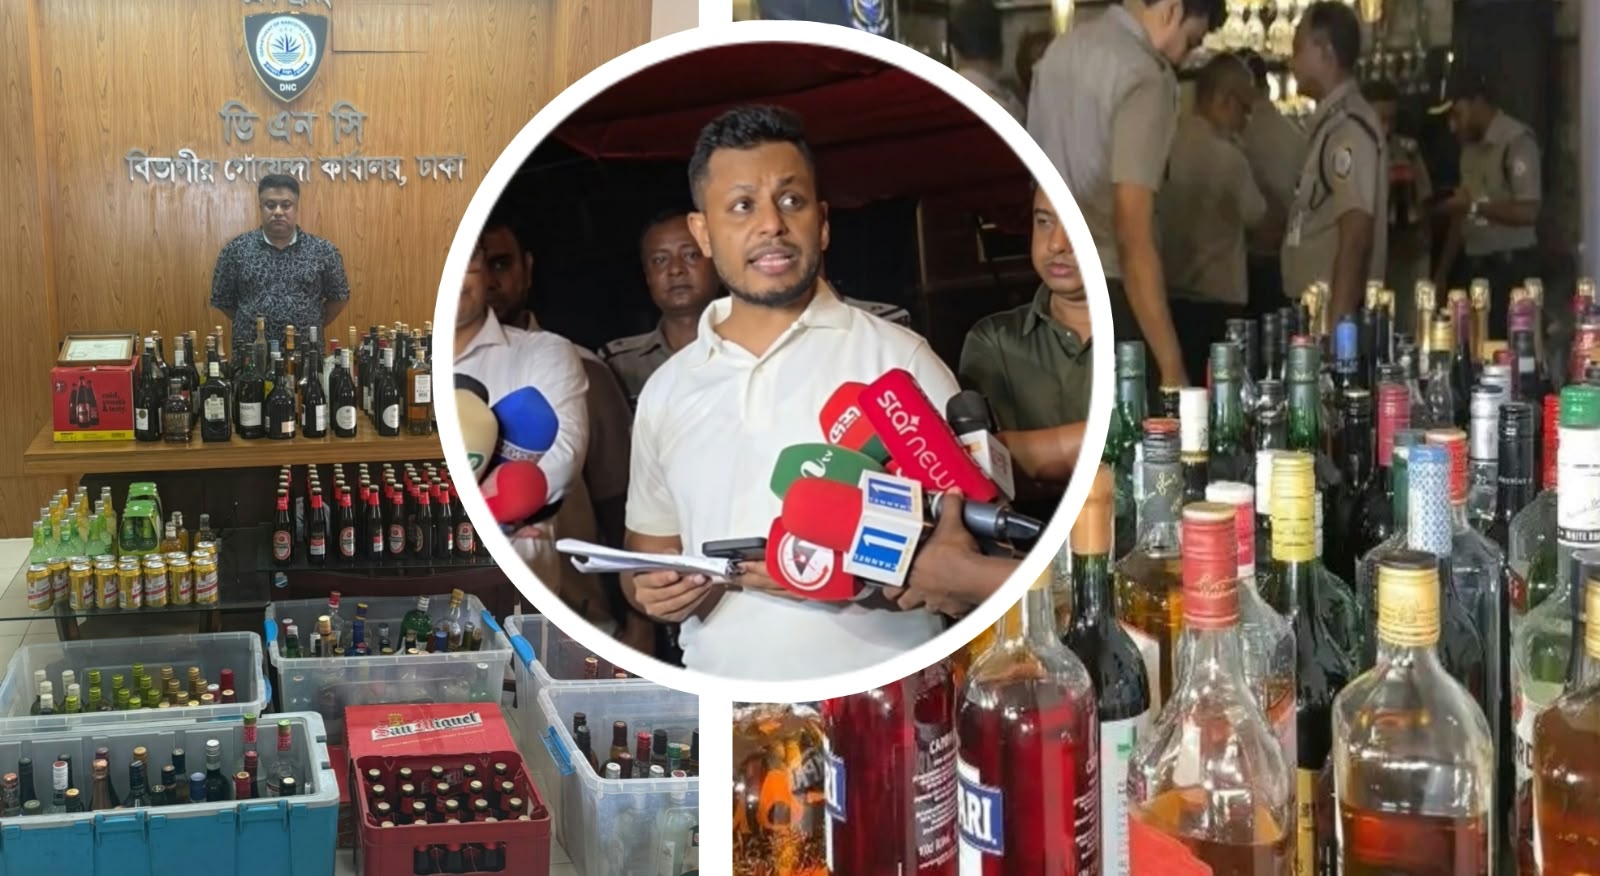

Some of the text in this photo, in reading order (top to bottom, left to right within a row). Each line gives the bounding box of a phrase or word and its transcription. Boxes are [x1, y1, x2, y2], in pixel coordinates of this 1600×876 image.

[279, 83, 297, 92] DNC
[219, 100, 260, 145] ডি
[329, 100, 368, 145] সি
[125, 147, 218, 184] বিভাগীয়
[415, 153, 467, 181] ঢাকা
[877, 390, 960, 495] star new
[853, 552, 897, 570] CHANNEL
[375, 724, 413, 737] San
